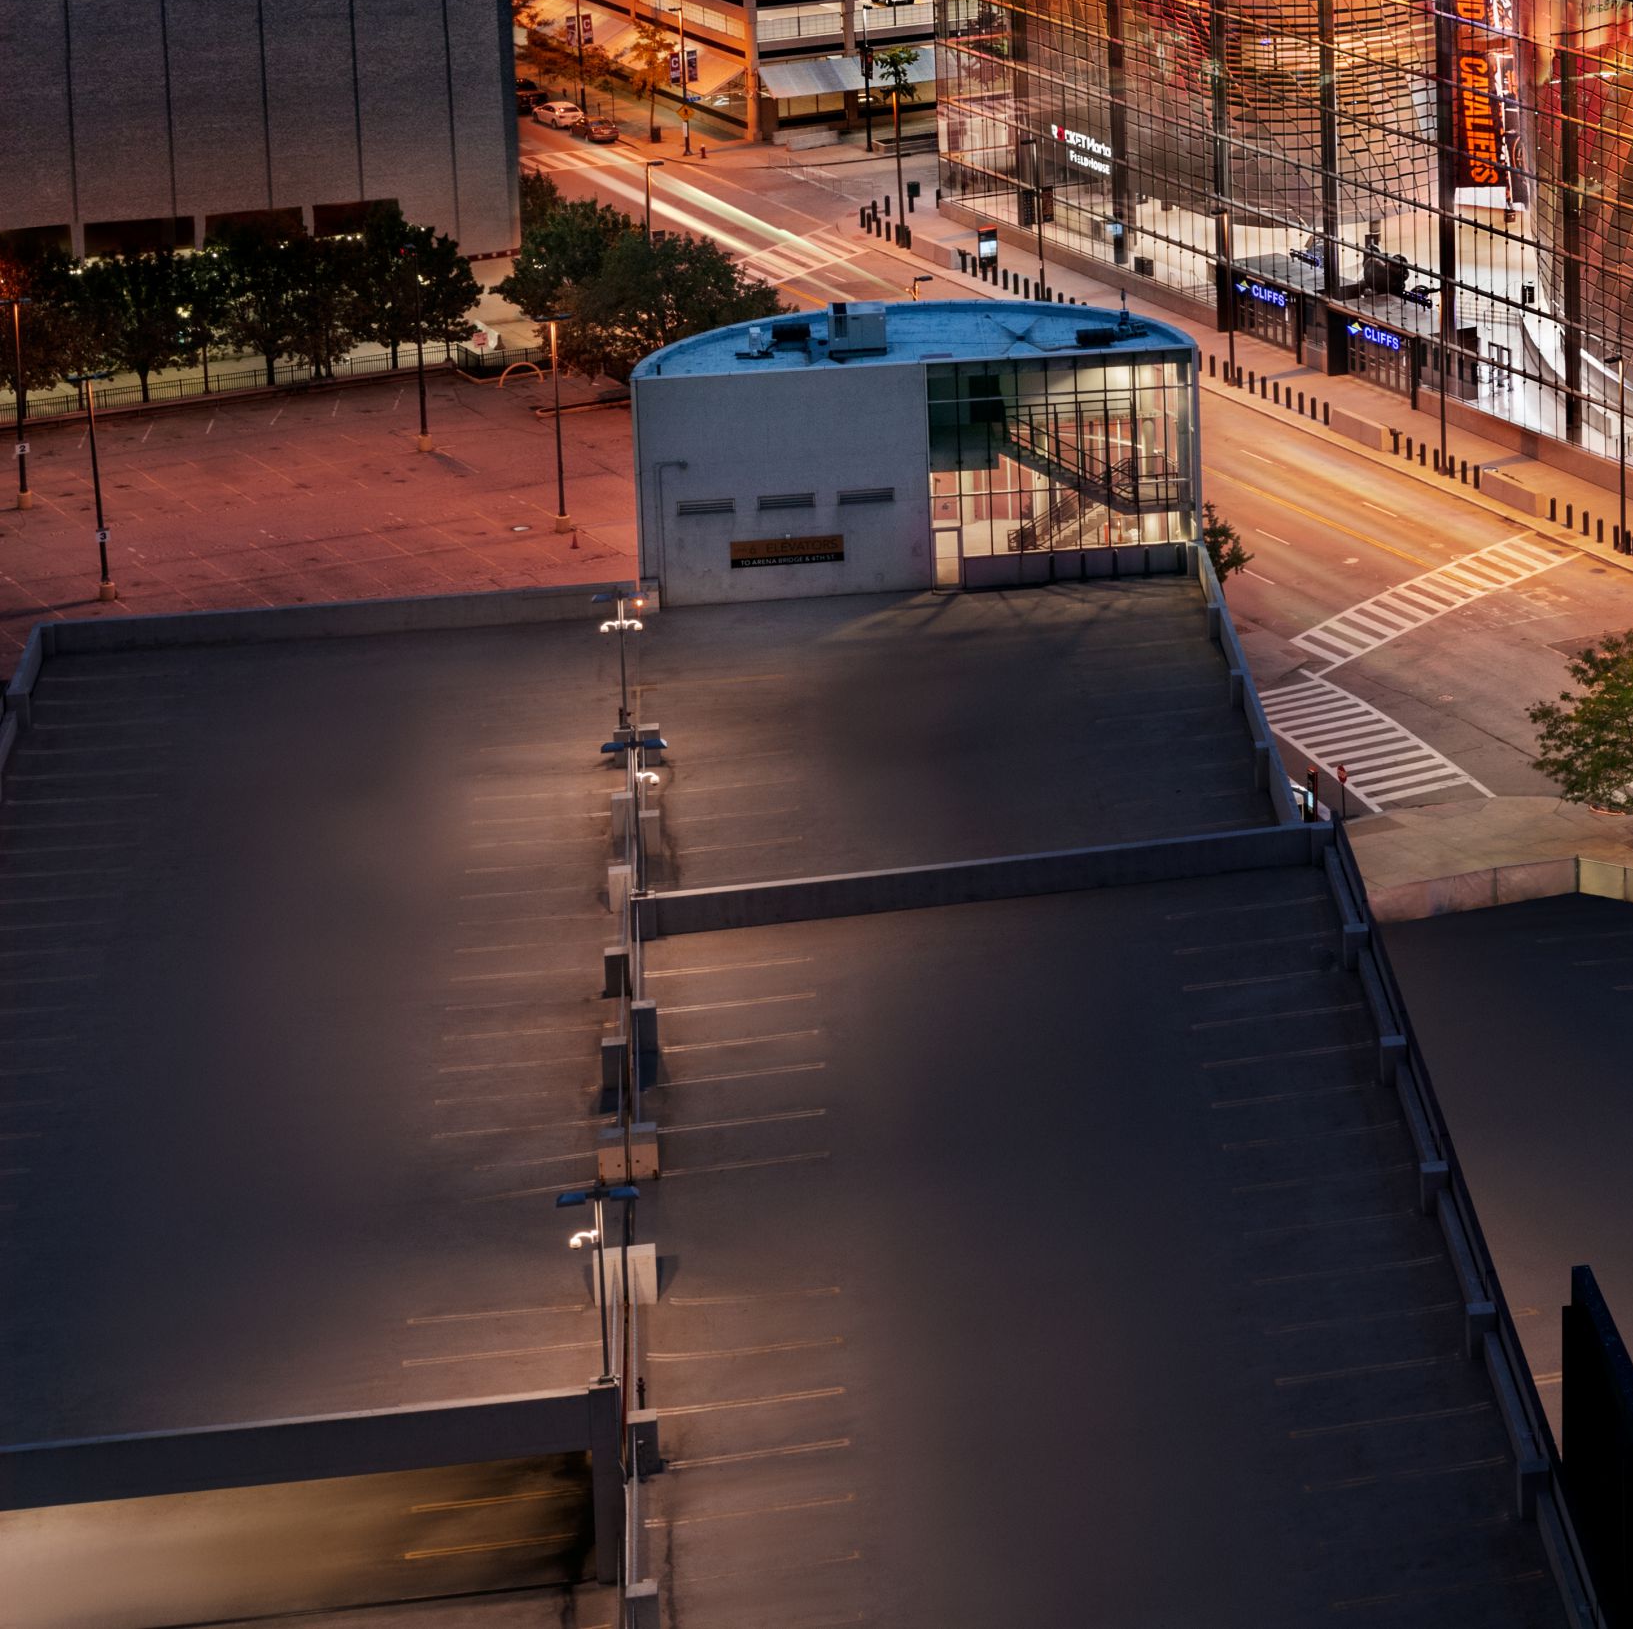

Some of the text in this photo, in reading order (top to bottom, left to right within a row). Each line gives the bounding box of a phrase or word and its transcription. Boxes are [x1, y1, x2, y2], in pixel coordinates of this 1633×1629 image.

[583, 18, 591, 29] C
[671, 56, 679, 67] C
[1459, 55, 1500, 185] CAVALIERS
[1050, 124, 1087, 149] ROCKET
[1070, 149, 1111, 175] FIELDHOUSE
[1252, 284, 1286, 308] CLIFFS
[1364, 326, 1400, 351] CLIFFS
[99, 532, 106, 540] 3
[766, 538, 838, 554] ELEVATORS
[752, 557, 777, 565] ARENA
[778, 556, 803, 564] BRIDGE
